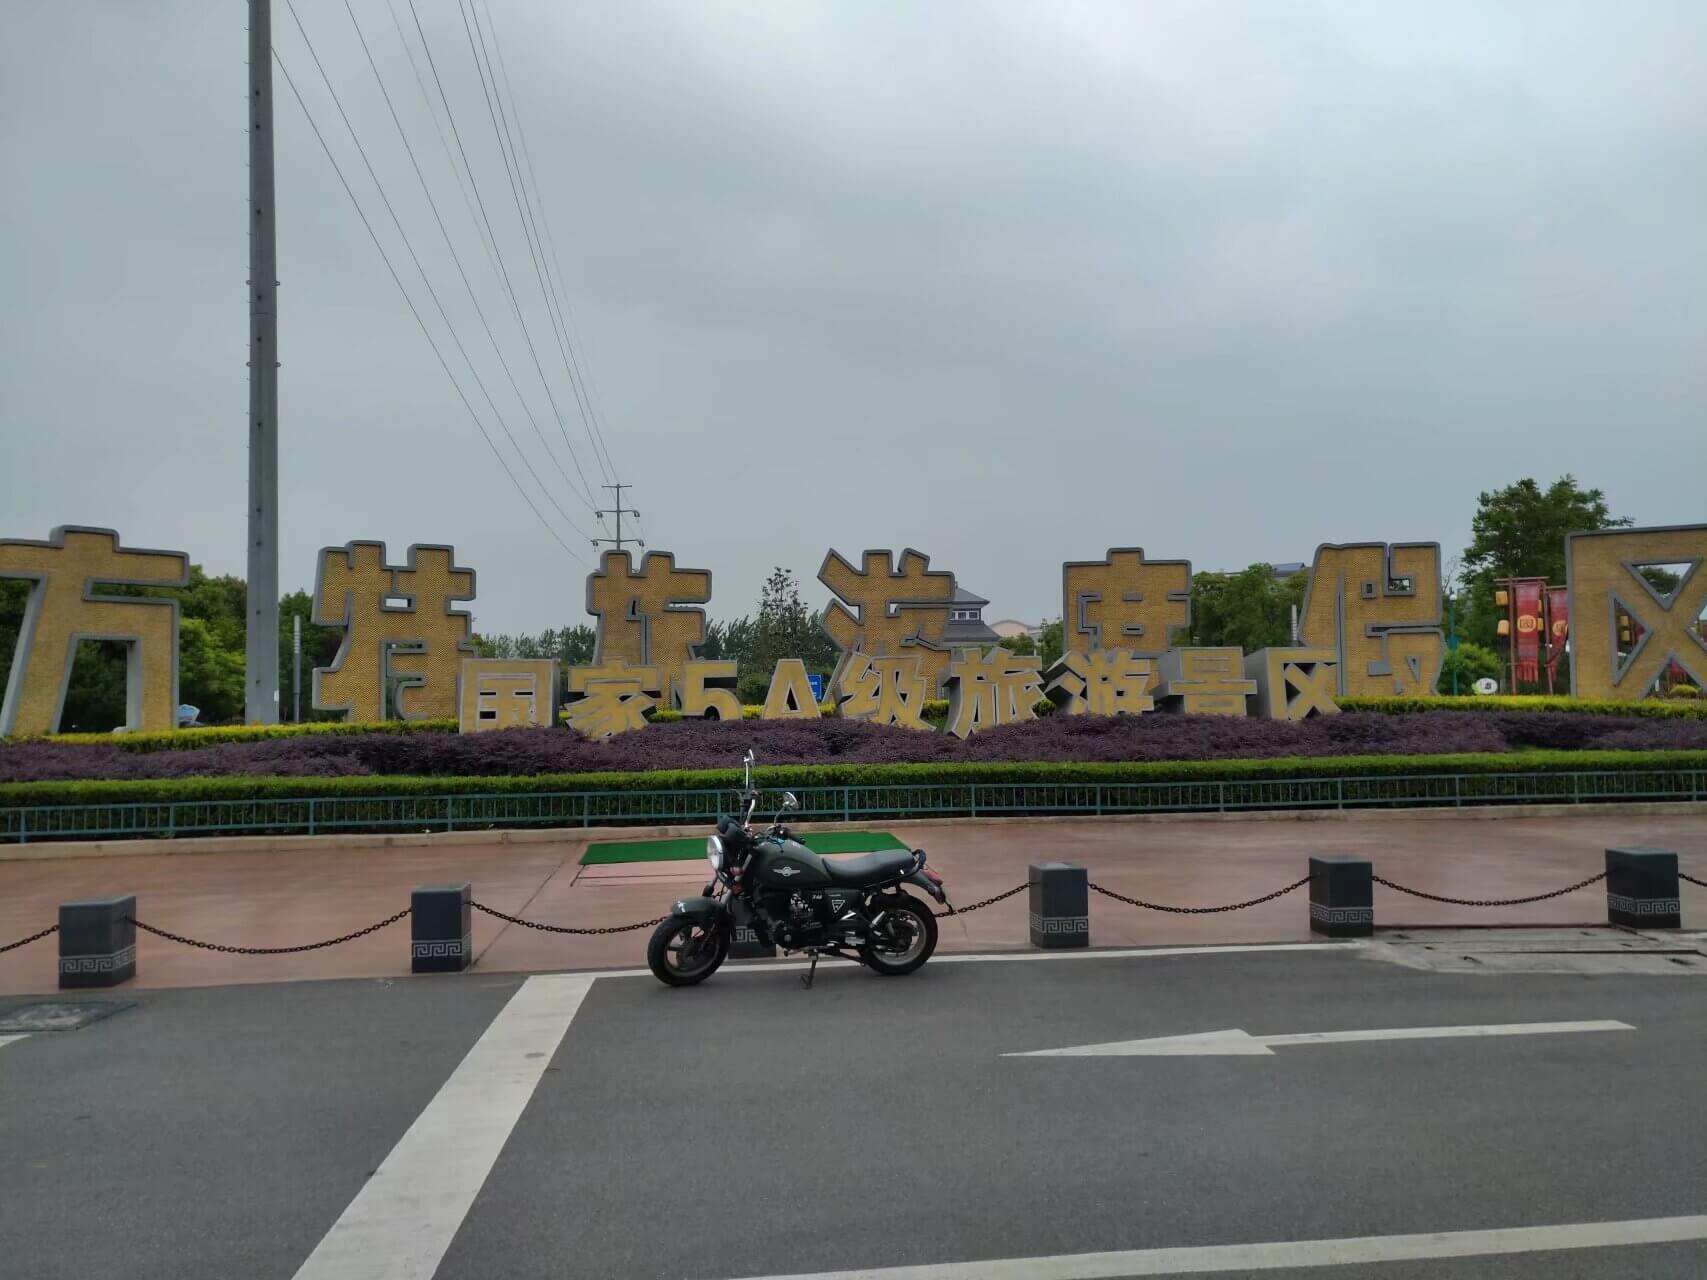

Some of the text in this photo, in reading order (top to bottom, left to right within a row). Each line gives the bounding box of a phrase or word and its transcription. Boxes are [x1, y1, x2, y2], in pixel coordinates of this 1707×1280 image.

[459, 647, 1341, 740] 国家5A级旅游景区
